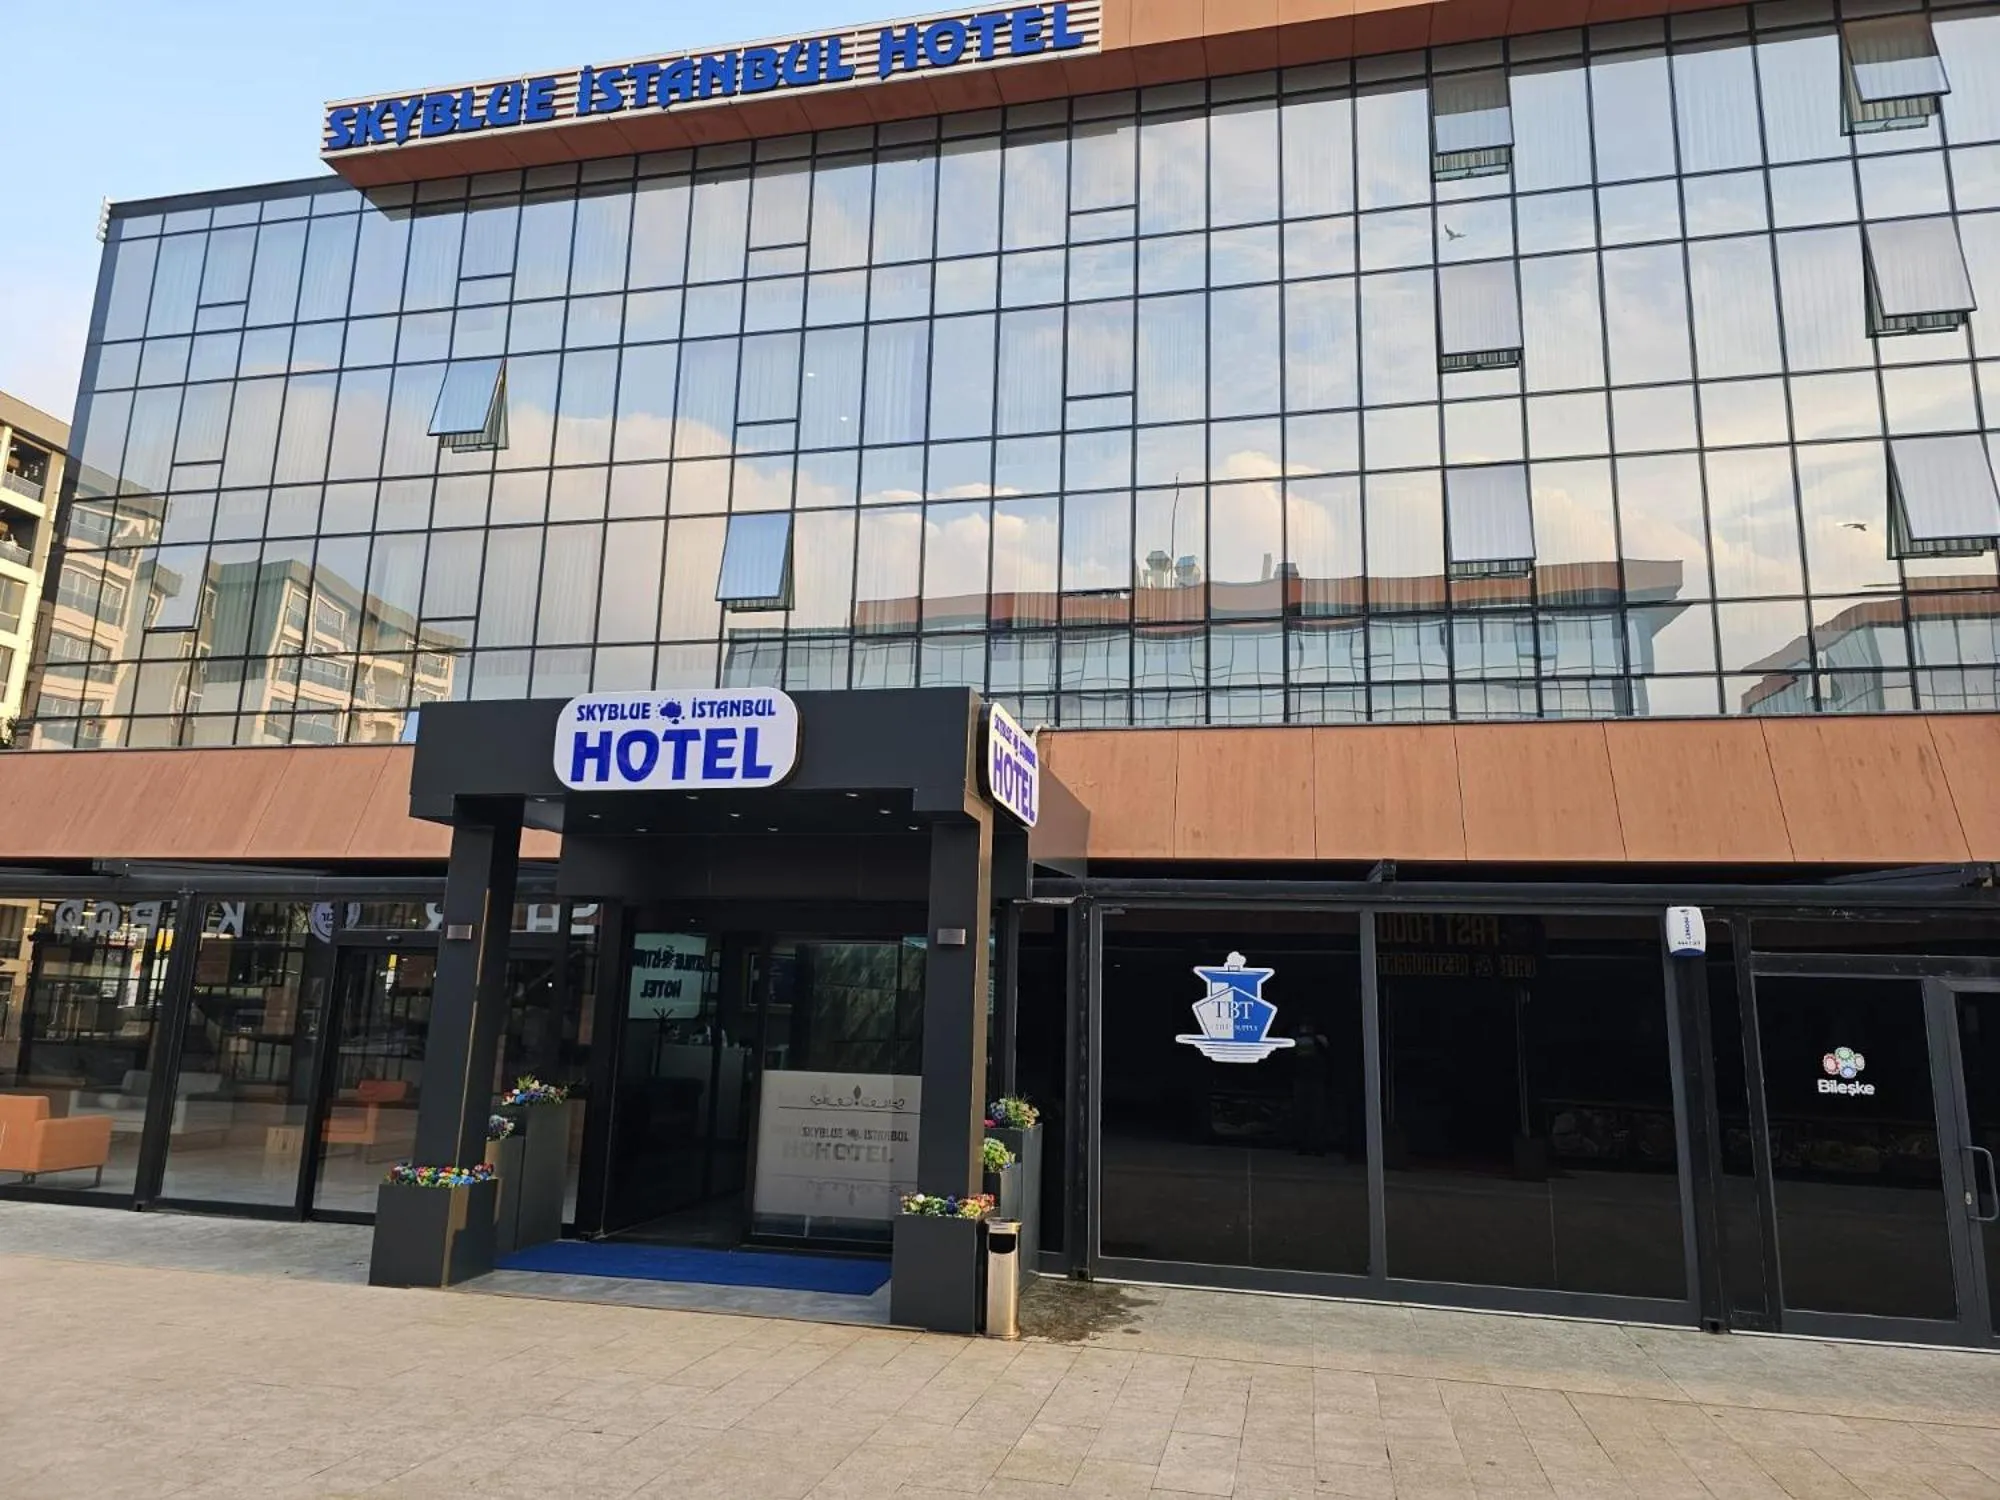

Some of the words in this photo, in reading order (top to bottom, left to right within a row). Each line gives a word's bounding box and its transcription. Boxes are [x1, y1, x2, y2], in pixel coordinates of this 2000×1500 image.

[327, 78, 556, 151] SKYBLUE
[576, 36, 856, 117] İSTANBUL
[876, 3, 1084, 80] HOTEL
[576, 702, 650, 722] SKYBLUE
[691, 697, 776, 718] İSTANBUL
[570, 727, 773, 783] HOTEL
[993, 740, 1036, 823] HOTEL
[1211, 1000, 1255, 1020] TBT
[1817, 1079, 1875, 1097] Bileşke
